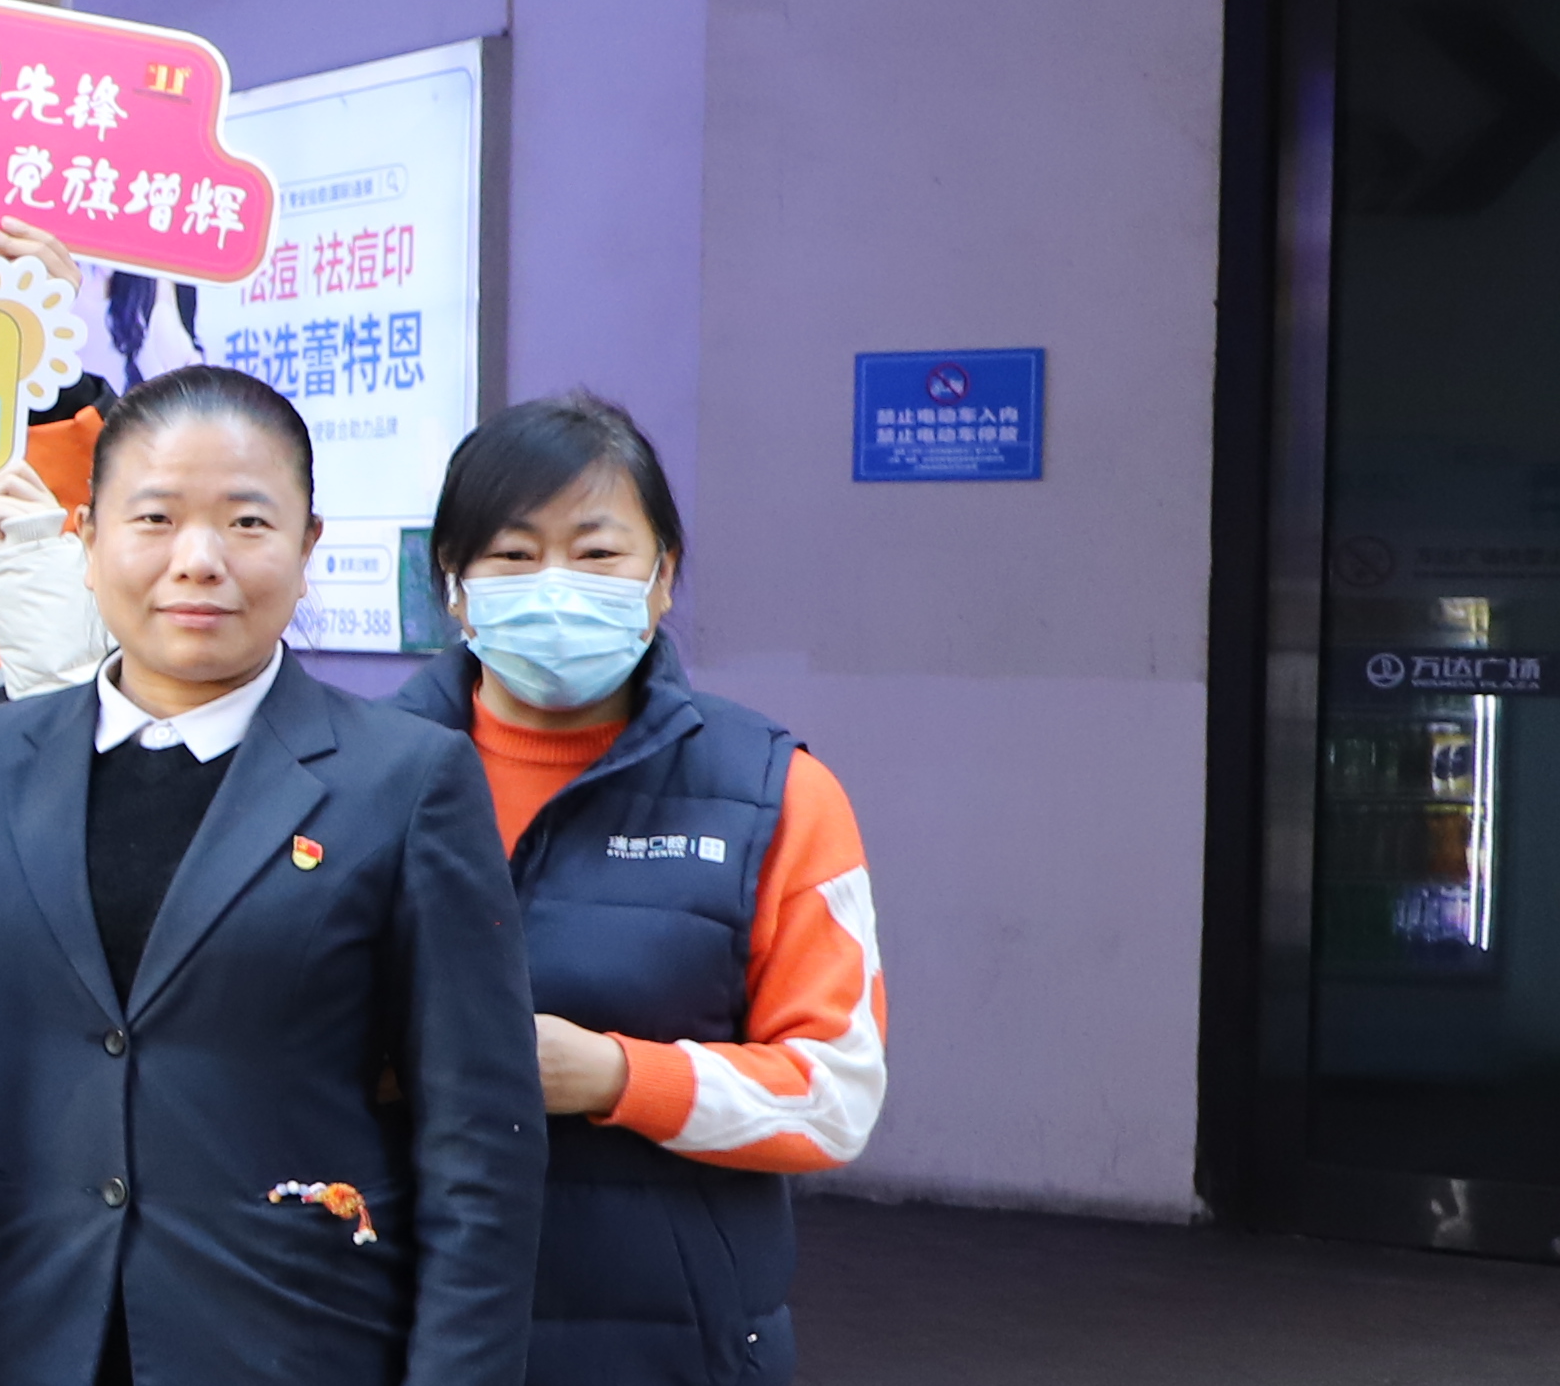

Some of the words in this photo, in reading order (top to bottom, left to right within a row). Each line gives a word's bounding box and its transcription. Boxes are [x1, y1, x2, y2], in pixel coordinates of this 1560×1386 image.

[314, 224, 414, 297] 祛痘印
[1411, 656, 1541, 679] 万达广场
